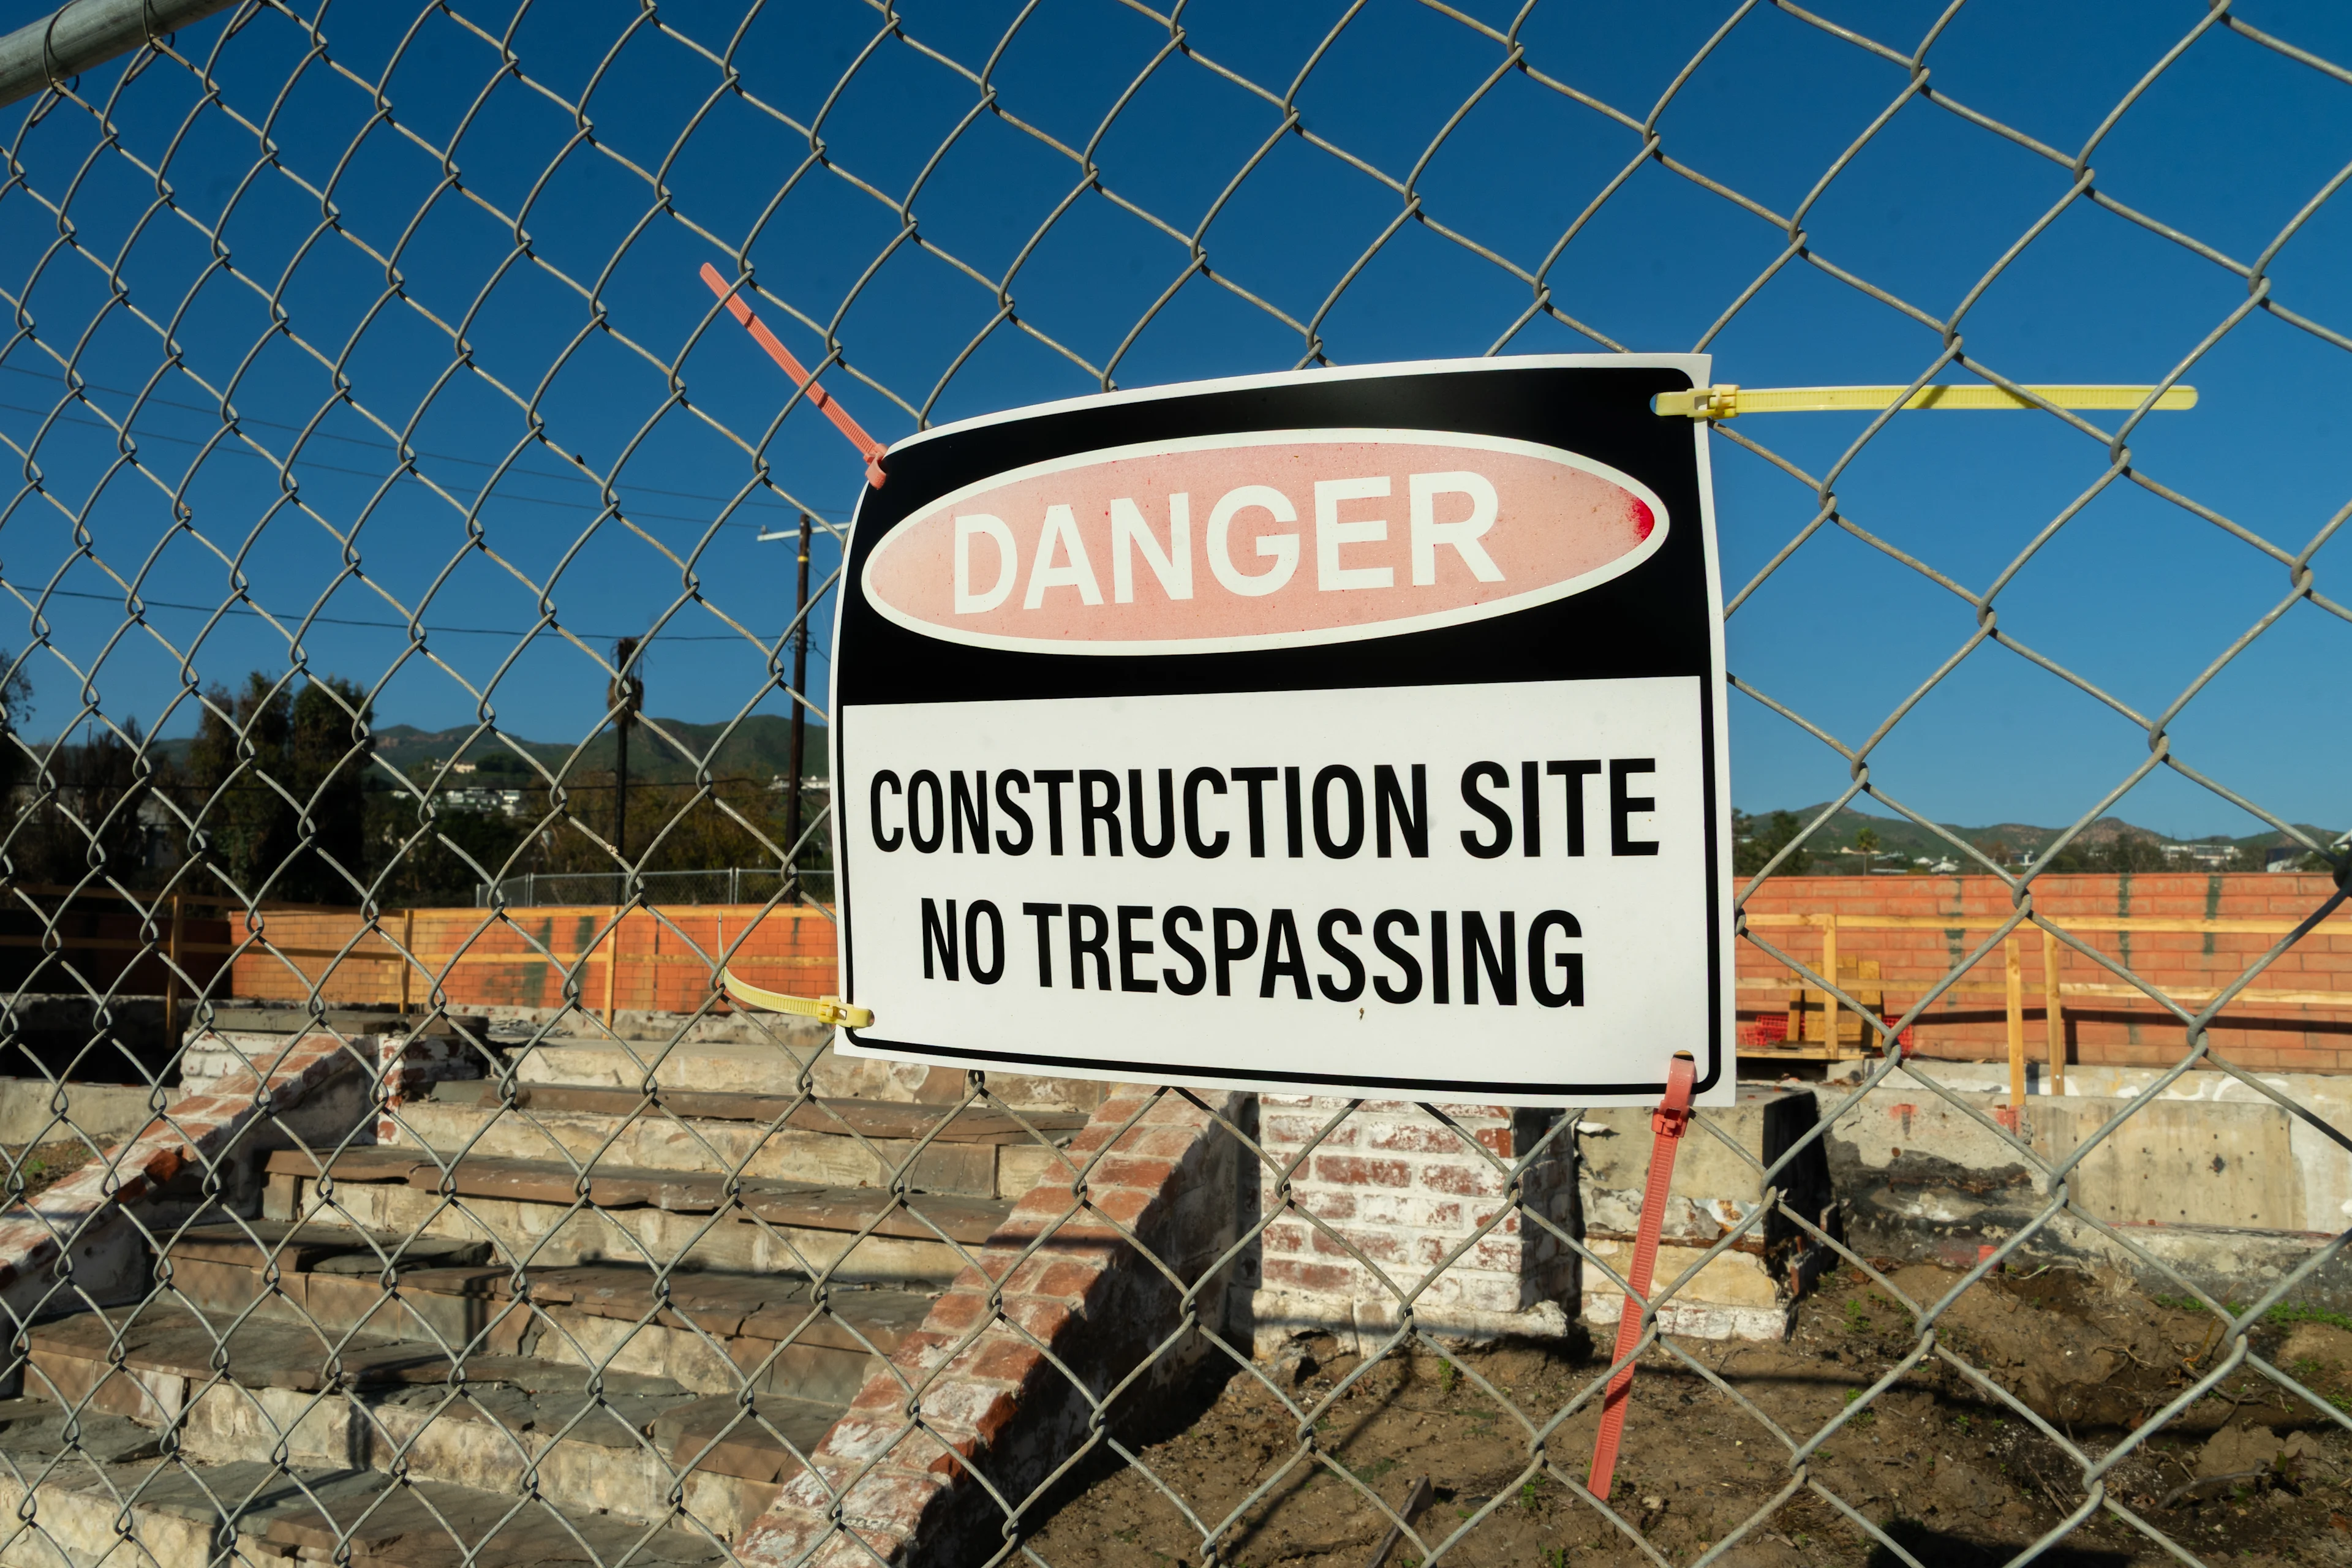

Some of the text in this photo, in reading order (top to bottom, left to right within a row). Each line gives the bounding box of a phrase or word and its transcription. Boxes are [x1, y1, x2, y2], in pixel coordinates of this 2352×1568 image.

[954, 470, 1506, 614] DANGER
[870, 758, 1660, 860] CONSTRUCTION SITE
[921, 897, 1585, 1008] NO TRESPASSING
